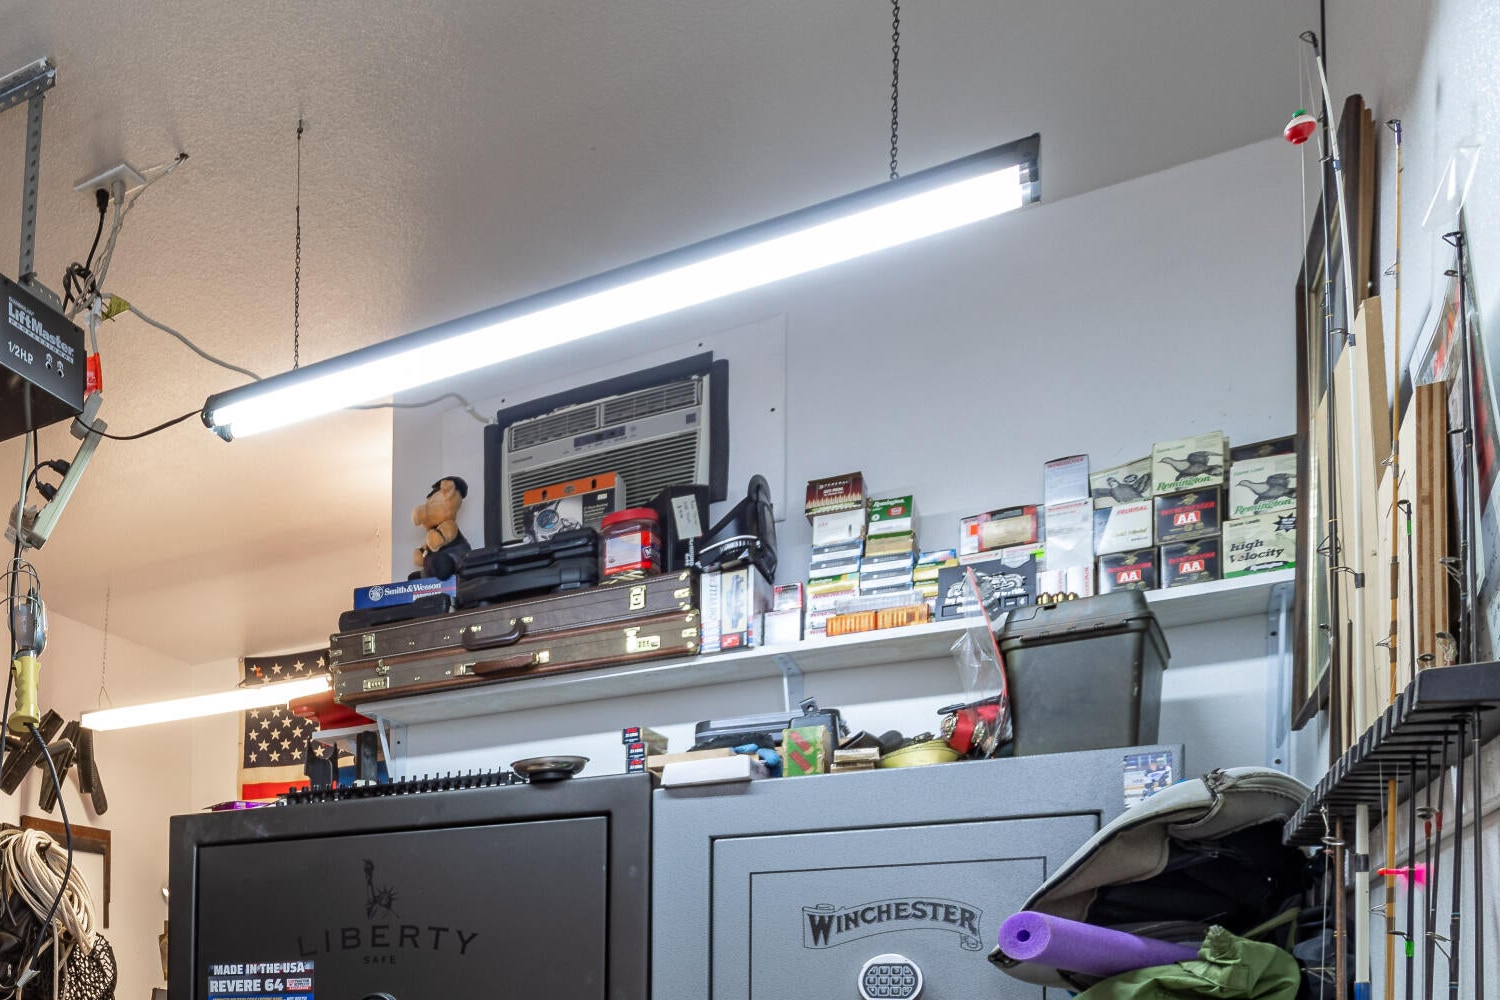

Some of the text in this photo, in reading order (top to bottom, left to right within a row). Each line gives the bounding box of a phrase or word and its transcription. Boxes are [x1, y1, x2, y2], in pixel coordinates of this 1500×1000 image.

[8, 301, 74, 357] LiftMaster
[1157, 477, 1211, 491] Remington
[1234, 499, 1292, 514] Remington
[1176, 513, 1197, 525] AA
[1230, 540, 1263, 552] High
[1230, 548, 1284, 563] Velocity
[1182, 561, 1201, 573] AA
[1120, 571, 1138, 583] AA
[808, 901, 978, 946] WINCHESTER
[298, 925, 479, 957] LIBERTY
[364, 955, 397, 965] SAFE
[214, 961, 305, 975] MADE IN THE USA
[210, 979, 261, 992] REVERE
[264, 979, 283, 991] 64
